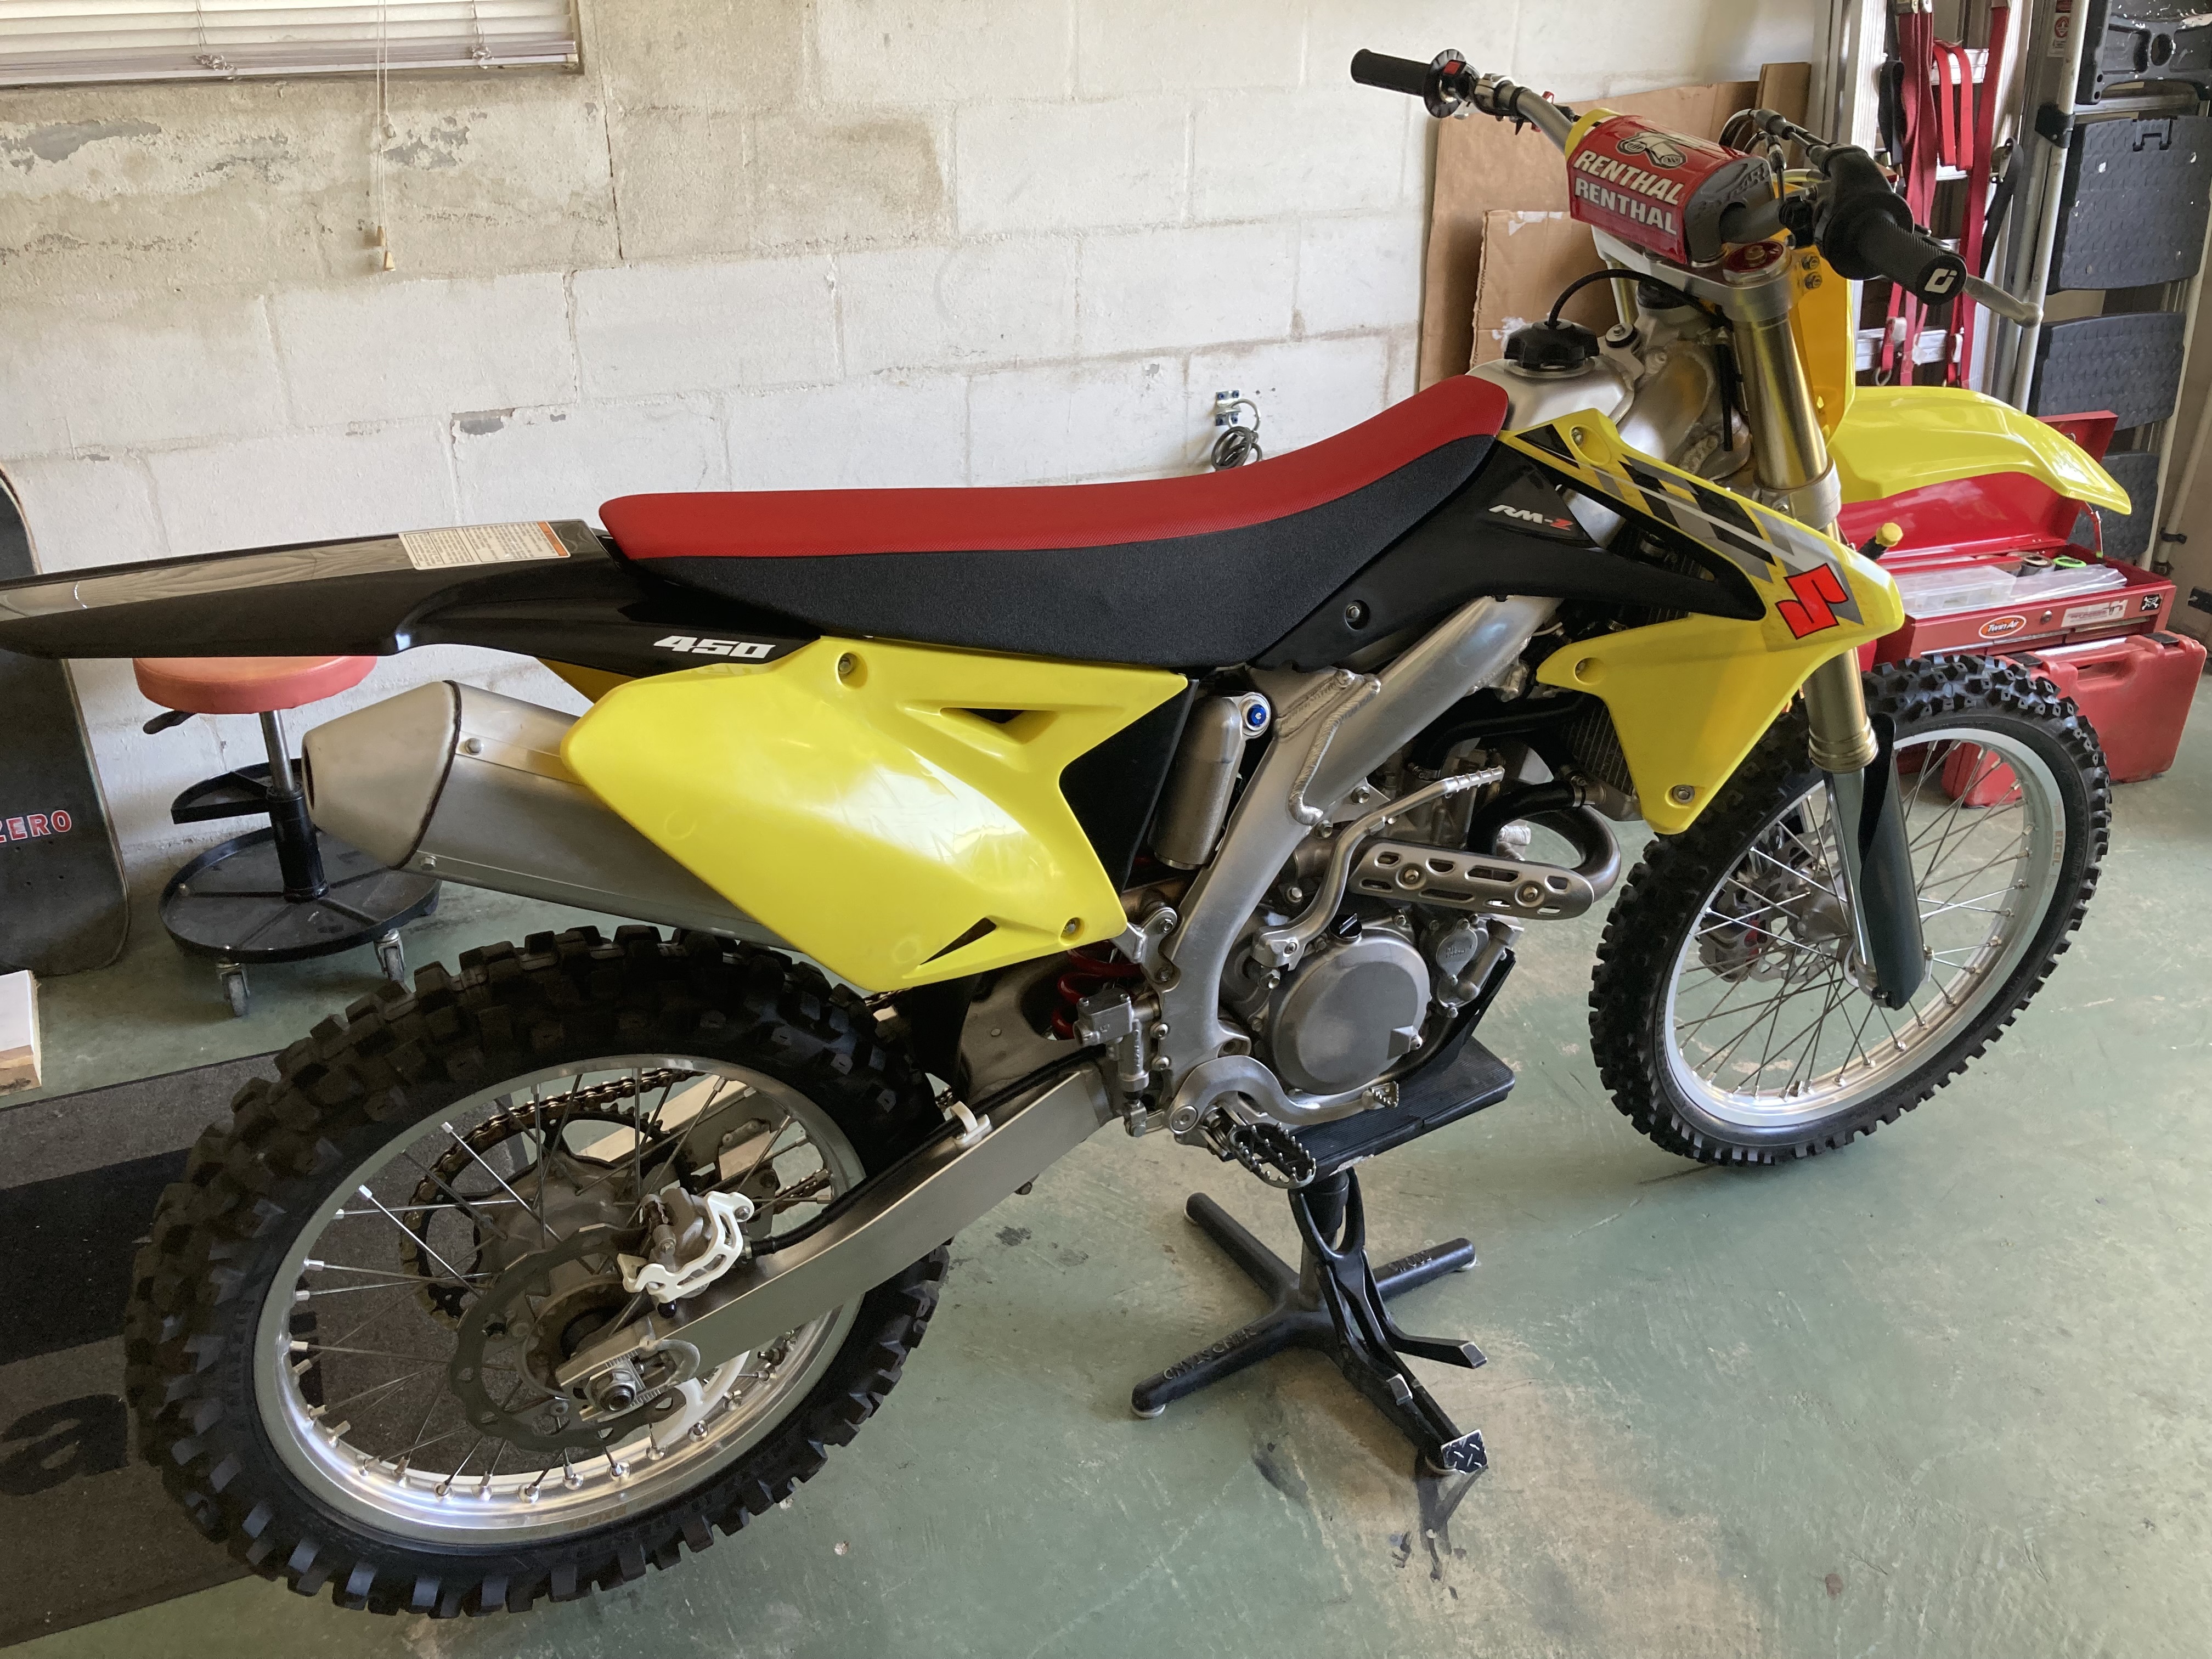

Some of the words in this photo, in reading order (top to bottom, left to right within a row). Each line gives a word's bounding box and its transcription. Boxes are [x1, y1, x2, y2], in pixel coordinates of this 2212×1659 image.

[1573, 150, 1684, 206] RENTHAL
[1575, 177, 1677, 235] RENTHAL
[1988, 624, 2007, 633] Twin
[653, 635, 776, 659] 450
[0, 810, 72, 843] ERO
